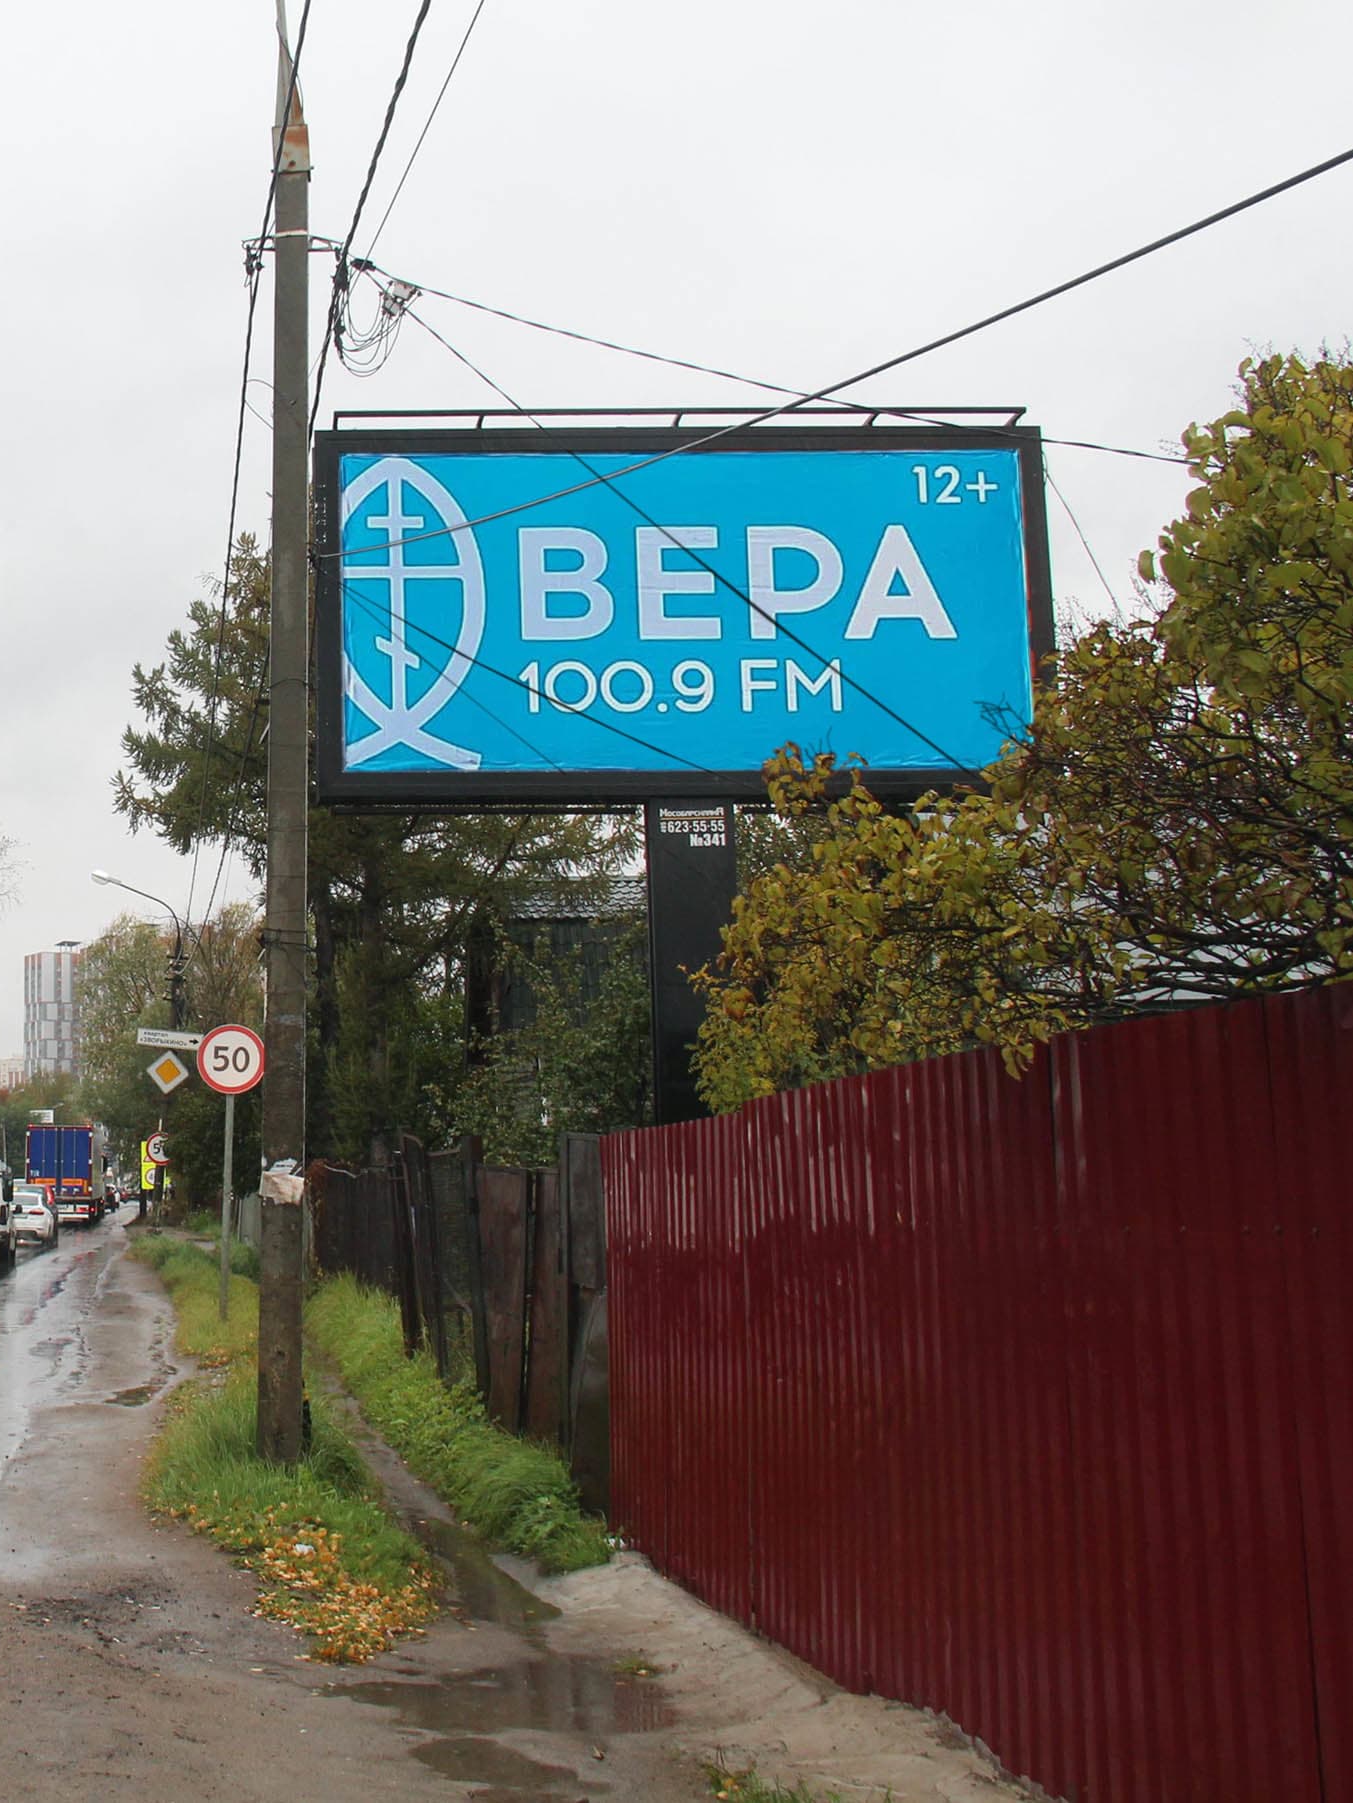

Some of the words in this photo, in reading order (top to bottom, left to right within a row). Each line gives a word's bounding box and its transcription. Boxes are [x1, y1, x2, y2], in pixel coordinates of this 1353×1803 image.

[911, 464, 999, 505] 12+
[516, 524, 958, 642] ВЕРА
[518, 659, 715, 715] 100.9
[739, 658, 844, 714] FM
[212, 1046, 251, 1073] 50
